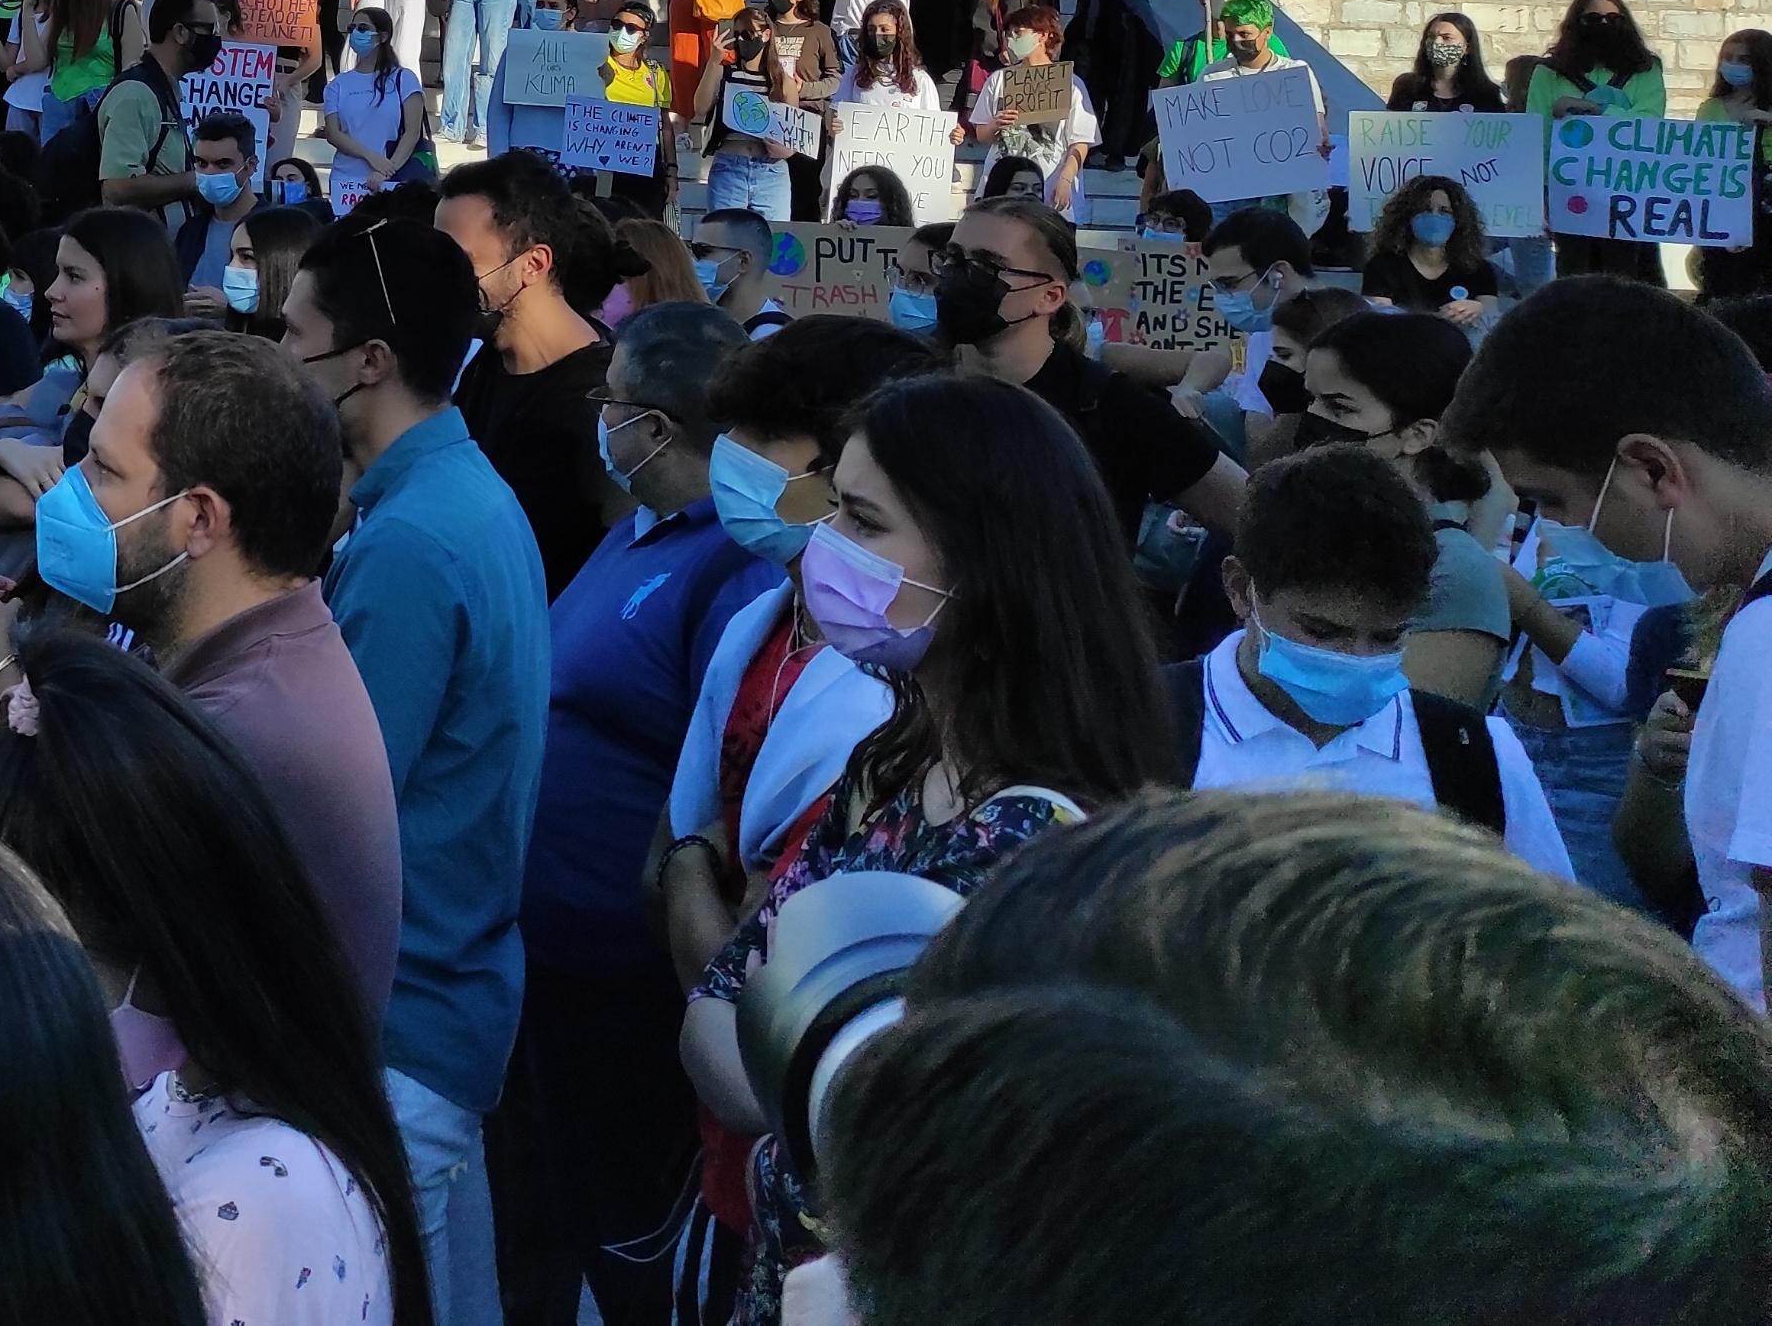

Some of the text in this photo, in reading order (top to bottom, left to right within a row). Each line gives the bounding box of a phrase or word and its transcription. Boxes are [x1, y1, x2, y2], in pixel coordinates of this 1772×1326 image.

[286, 11, 304, 24] OF
[256, 24, 313, 42] PLANET!
[525, 73, 575, 95] KLIMA
[1004, 65, 1068, 88] PLANET
[1004, 89, 1064, 113] PROFIT
[1164, 75, 1305, 129] MAKE LOVE
[567, 102, 653, 126] THE CLIMATE
[784, 106, 806, 129] I'M
[568, 120, 639, 137] IS CHANGING
[778, 121, 814, 145] WITH
[851, 110, 947, 146] EARTH
[1360, 118, 1513, 149] RAISE YOUR
[1607, 118, 1752, 160] CLIMATE
[567, 134, 606, 154] WHY
[1178, 126, 1314, 175] NOT CO2
[911, 154, 946, 179] YOU
[1460, 158, 1500, 187] NOT
[1552, 156, 1749, 199] CHANGE IS
[340, 181, 355, 190] WE
[1608, 194, 1730, 240] REAL
[815, 237, 876, 283] PUT
[1140, 252, 1187, 278] ITS
[781, 284, 878, 309] TRASH
[1135, 279, 1185, 305] THE
[1136, 310, 1188, 335] AND
